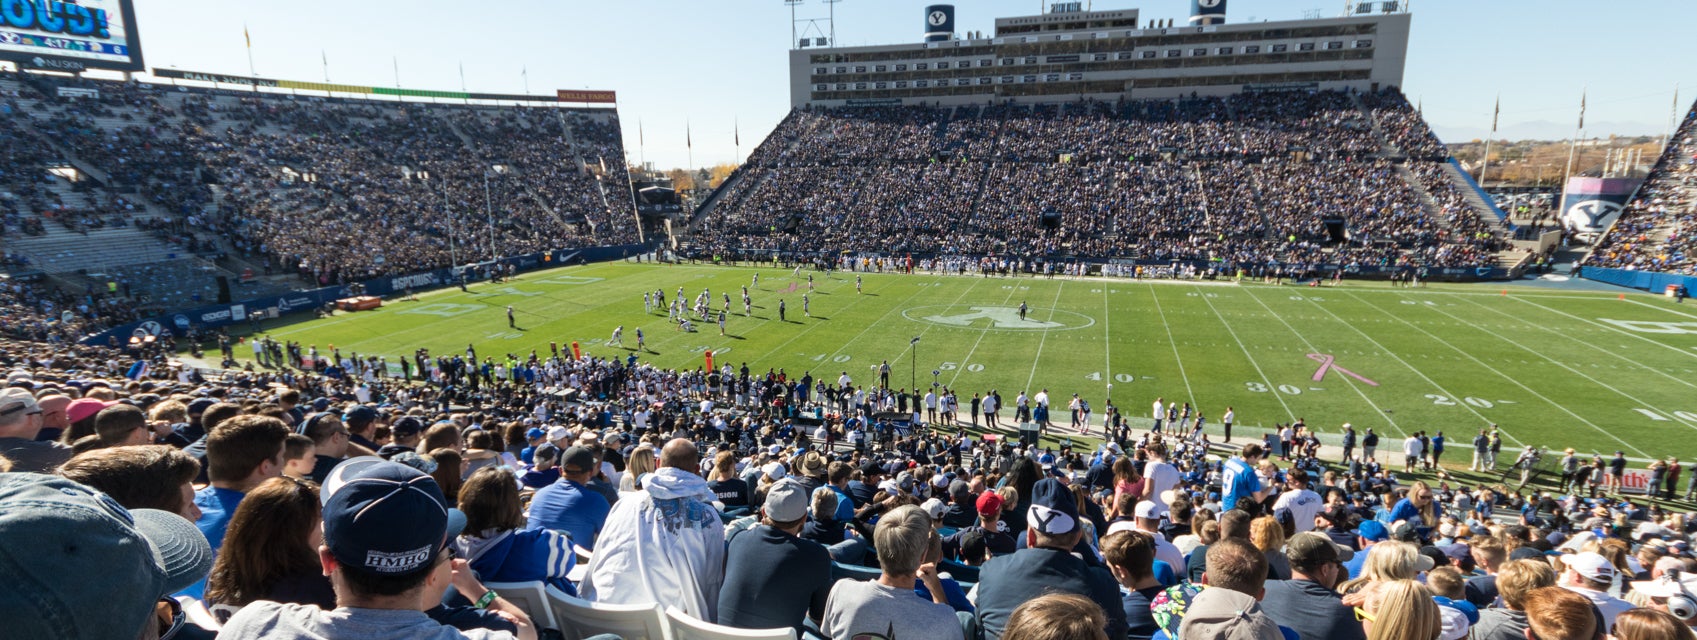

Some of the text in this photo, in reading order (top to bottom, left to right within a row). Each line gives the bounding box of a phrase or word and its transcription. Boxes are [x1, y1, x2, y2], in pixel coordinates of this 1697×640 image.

[0, 0, 110, 38] OUD!
[1578, 204, 1619, 228] Y
[939, 361, 985, 372] 50
[1085, 371, 1135, 383] 40
[1245, 381, 1302, 395] 30
[1424, 394, 1494, 408] 20
[1031, 506, 1062, 534] Y
[368, 551, 427, 566] HMHO
